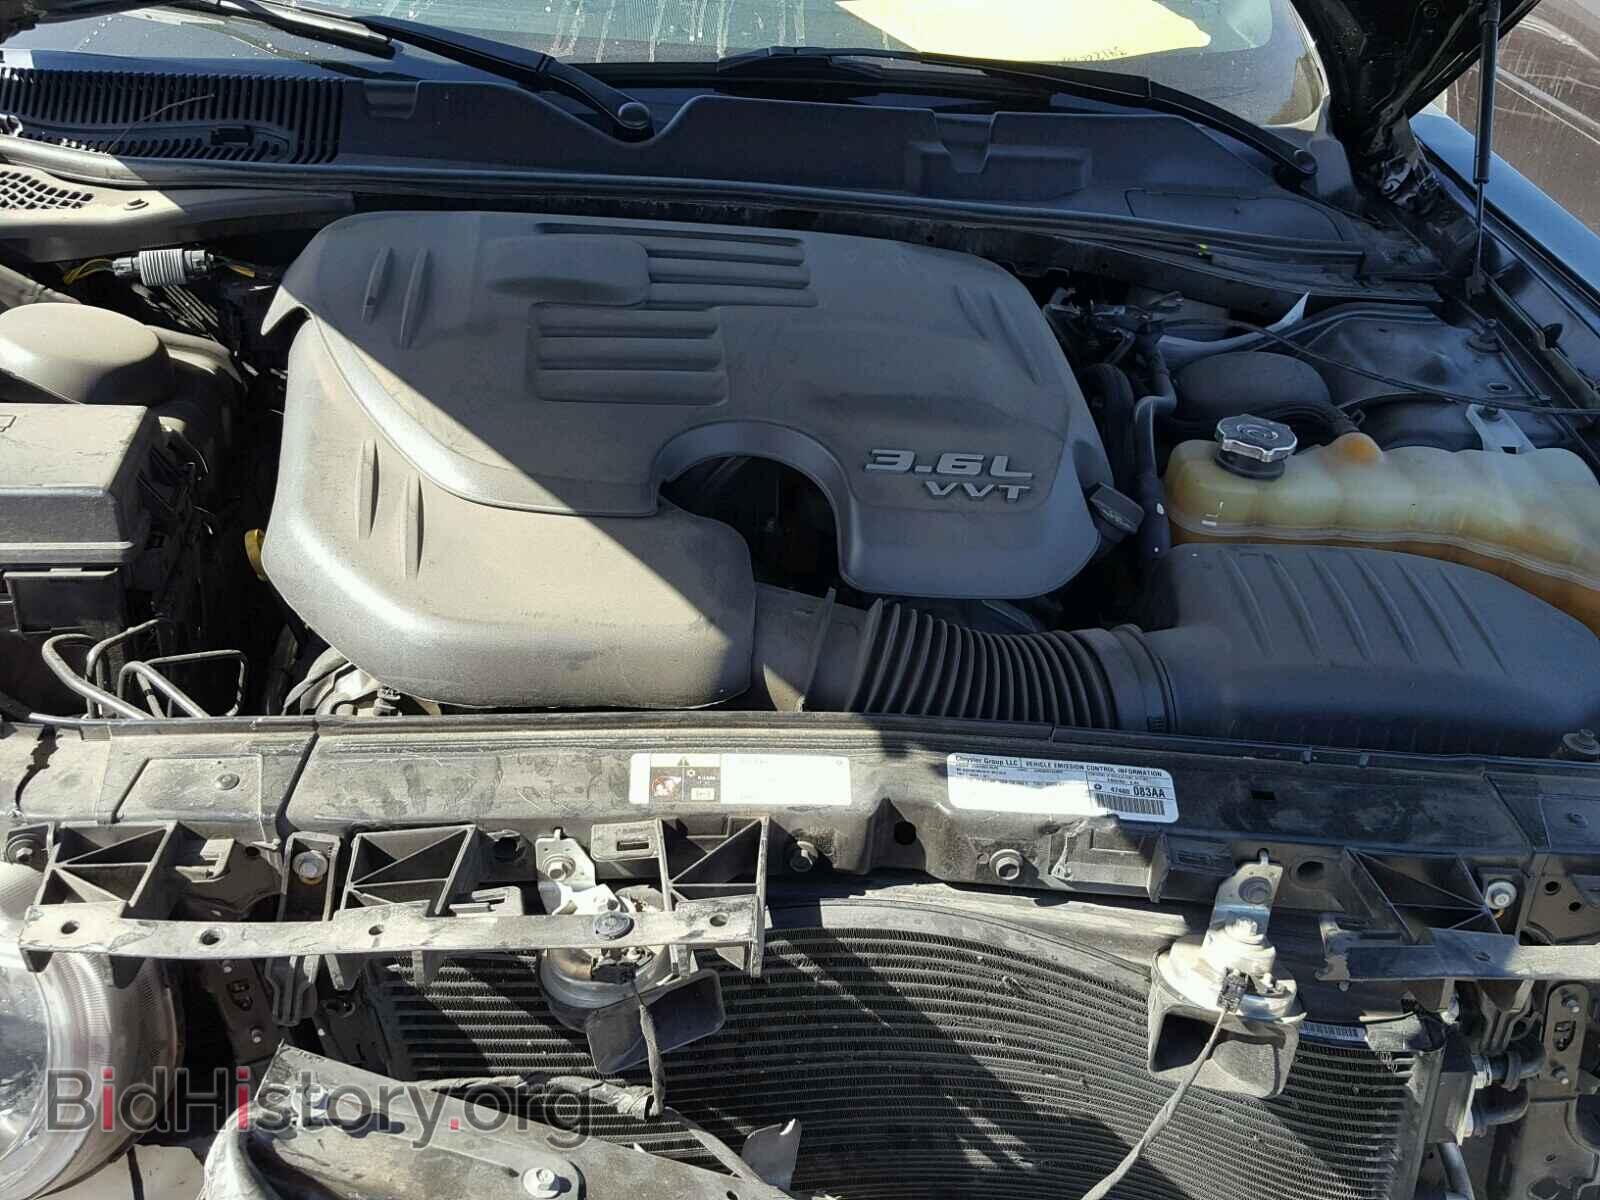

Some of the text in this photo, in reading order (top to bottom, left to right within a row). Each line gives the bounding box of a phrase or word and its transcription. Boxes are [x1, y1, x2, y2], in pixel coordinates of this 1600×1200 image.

[864, 449, 1033, 478] 3.6L
[924, 480, 1032, 501] VVT
[955, 755, 982, 764] Cysler
[983, 758, 1004, 767] Group
[1005, 759, 1018, 767] LLC
[1026, 761, 1052, 769] VEHICLE
[1086, 765, 1115, 774] CONTROL
[1118, 767, 1162, 777] INFORMATION
[1132, 785, 1166, 798] 083AA
